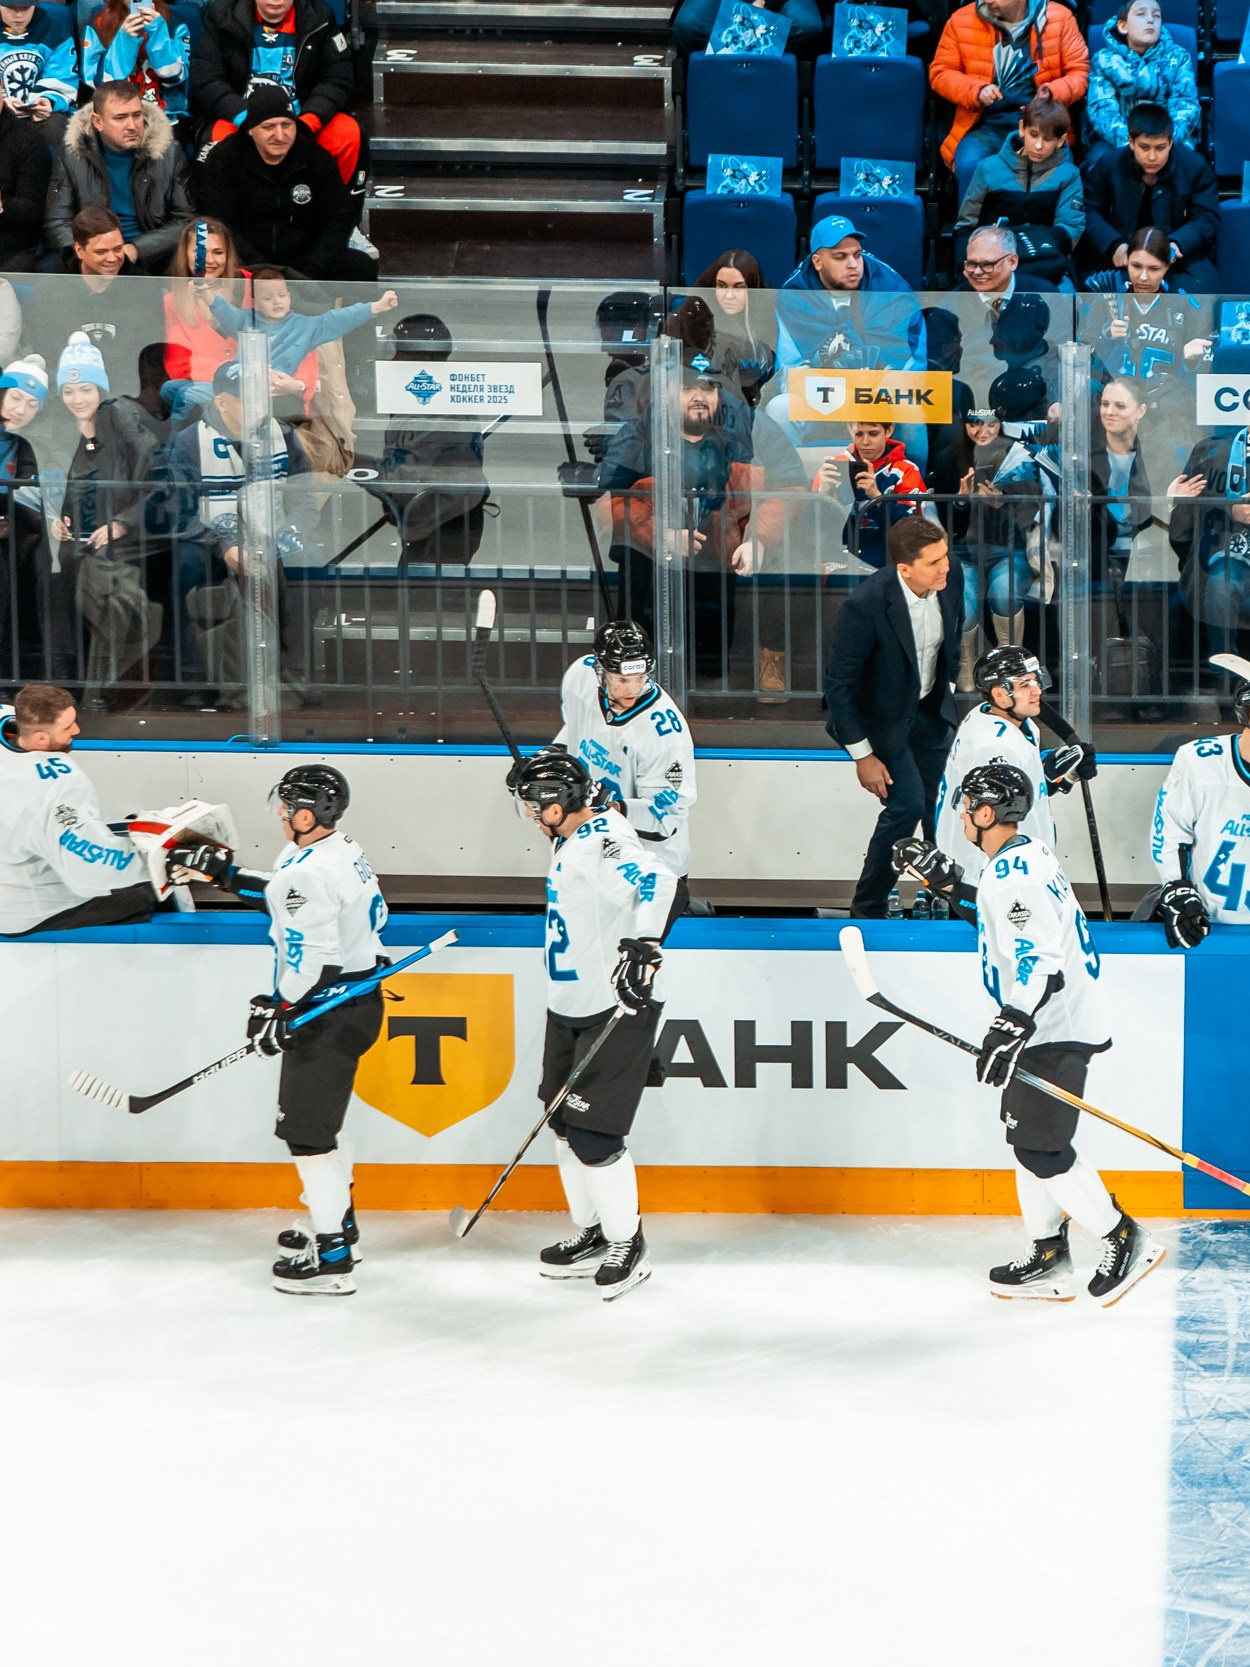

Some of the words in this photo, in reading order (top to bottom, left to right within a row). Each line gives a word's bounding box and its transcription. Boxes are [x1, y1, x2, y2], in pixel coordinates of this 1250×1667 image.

[449, 373, 486, 383] ФОНБЕТ
[450, 384, 485, 394] НЕДЕЛЯ
[487, 384, 515, 395] ЗВЕЗД
[450, 394, 485, 404] ХОККЕЯ
[487, 395, 508, 405] 2025
[854, 387, 935, 406] БАНК
[650, 708, 683, 737] 28
[993, 721, 1007, 738] 7
[35, 757, 73, 780] 45
[576, 817, 611, 840] 92
[994, 855, 1030, 879] 94
[645, 1019, 907, 1090] АНК
